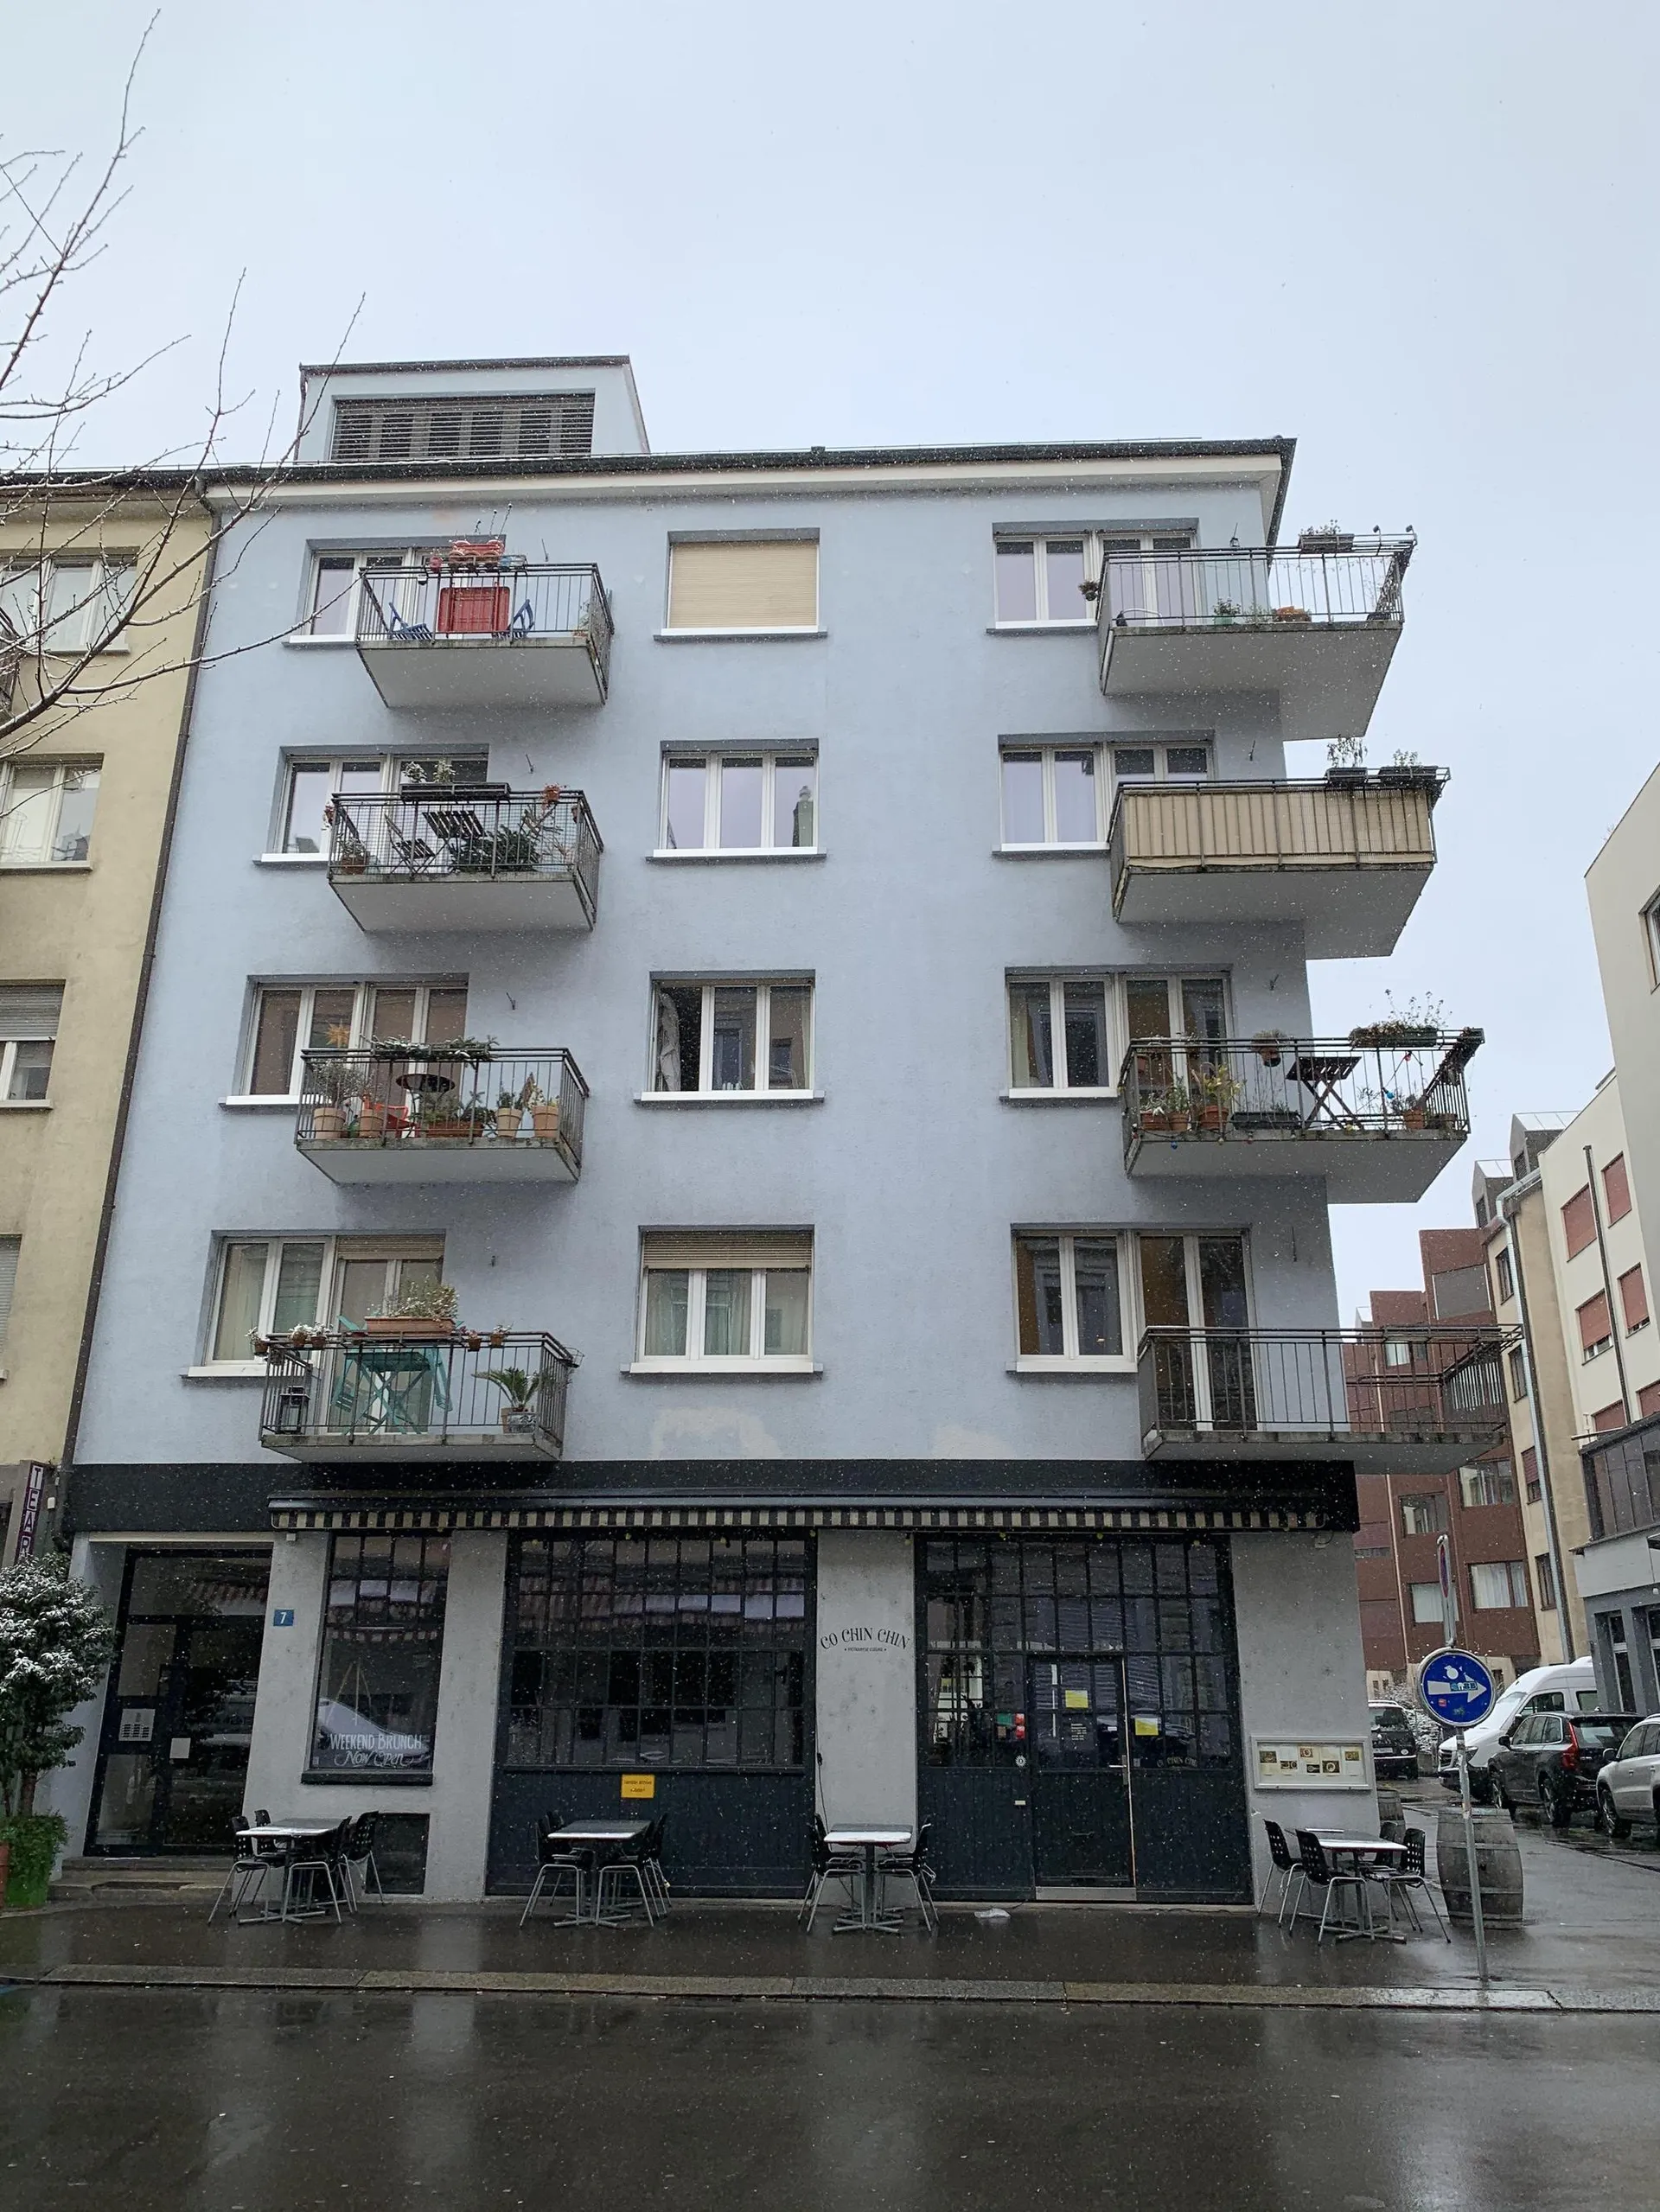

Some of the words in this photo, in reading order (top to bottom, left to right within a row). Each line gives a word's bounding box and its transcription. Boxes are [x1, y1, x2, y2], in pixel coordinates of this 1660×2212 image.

[280, 1611, 287, 1624] 7
[820, 1633, 838, 1649] CO
[841, 1627, 872, 1643] CHIN
[878, 1629, 910, 1650] CHIN
[329, 1733, 375, 1750] WEEKEND
[378, 1733, 423, 1750] BRUNCH
